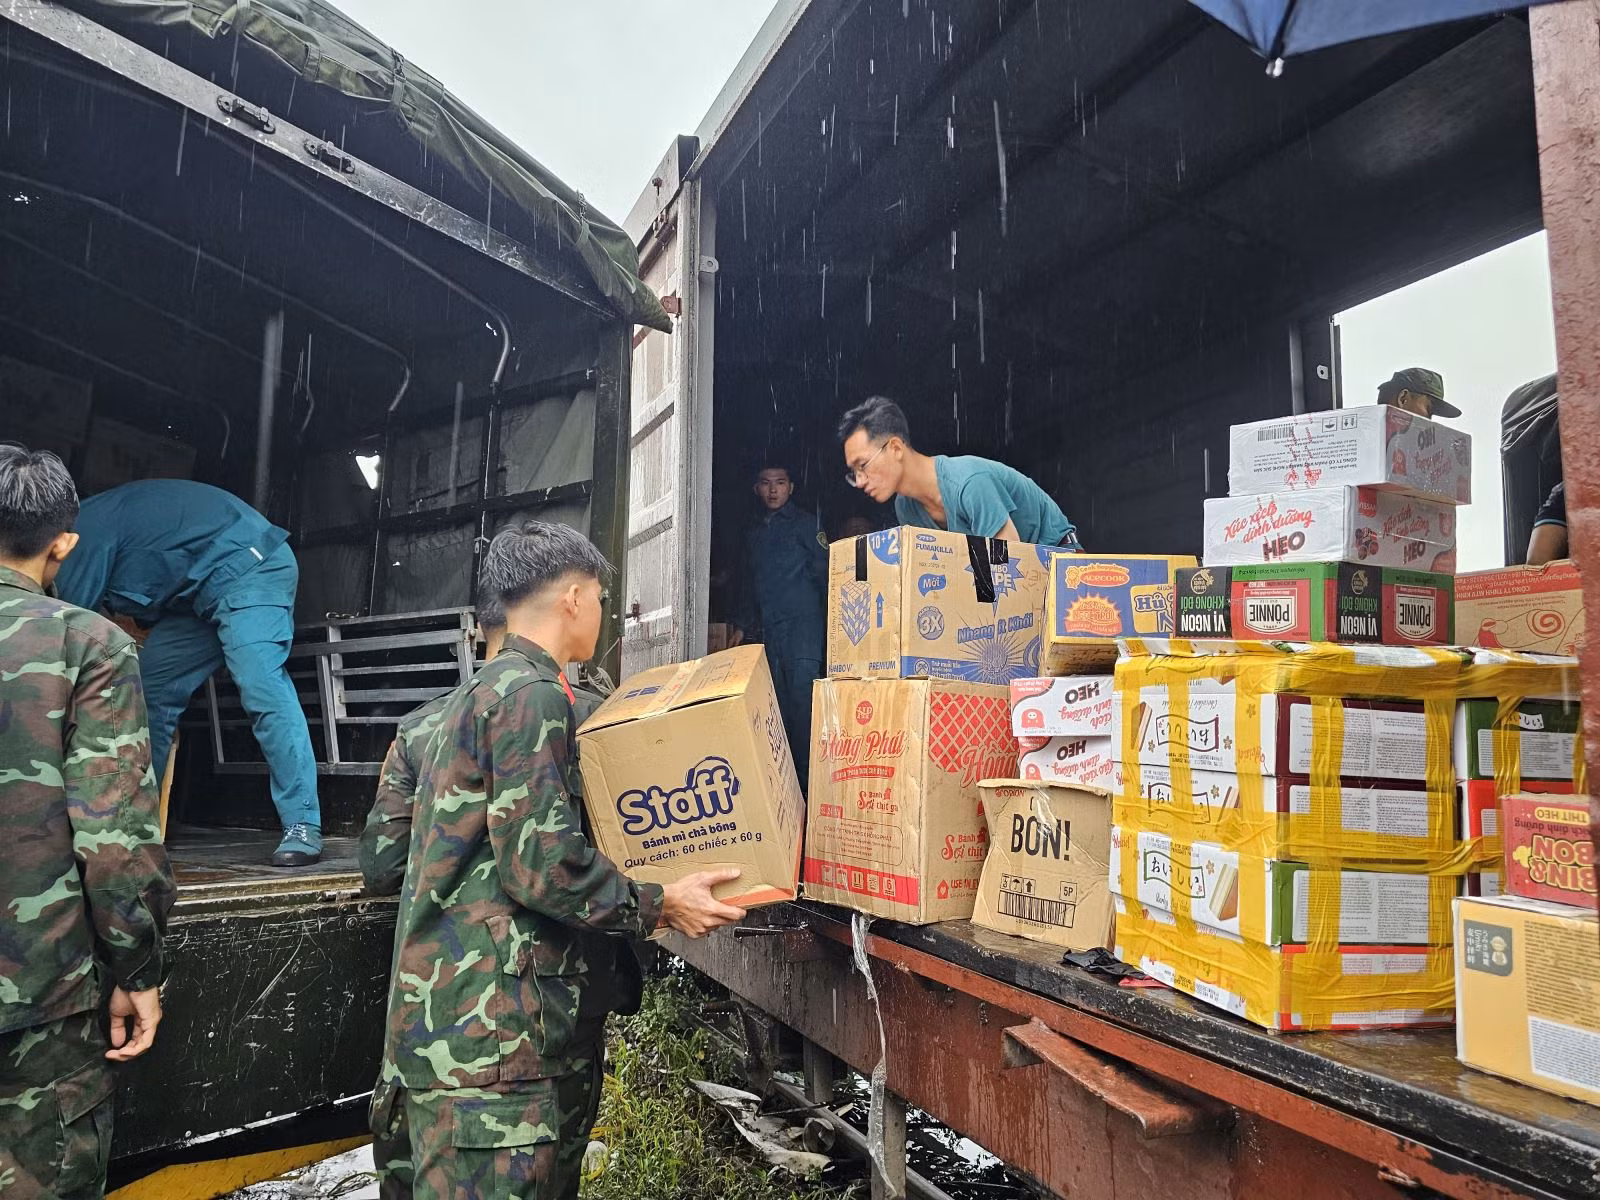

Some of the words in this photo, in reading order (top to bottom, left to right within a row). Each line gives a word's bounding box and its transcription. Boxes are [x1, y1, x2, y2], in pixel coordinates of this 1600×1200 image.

[1224, 519, 1247, 542] Xúc
[1242, 521, 1271, 544] dinh
[1272, 509, 1315, 530] dưỡng
[916, 543, 954, 554] FUMAKILLA
[1262, 531, 1306, 561] HEO
[1403, 539, 1426, 565] HEO
[923, 576, 940, 588] Mới
[993, 573, 1012, 588] APE
[1195, 596, 1224, 610] KHÔNG
[1249, 604, 1290, 624] PÖNNIE
[1354, 597, 1378, 613] KHÔNG
[918, 614, 943, 636] 3X
[958, 625, 994, 644] Nhang
[1008, 613, 1034, 631] Khói
[1181, 614, 1211, 632] NGON
[1213, 611, 1226, 632] VỊ
[1340, 616, 1366, 635] NGON
[1367, 614, 1378, 636] VỊ
[869, 661, 896, 671] PREMIUM
[1065, 682, 1100, 704] HEO
[820, 727, 863, 766] Hồng
[864, 729, 908, 761] Phát
[1057, 740, 1087, 761] HEO
[617, 765, 736, 836] Staff
[1537, 809, 1558, 820] HEO
[642, 834, 671, 850] Bánh
[672, 830, 687, 843] mì
[688, 826, 708, 839] chà
[710, 821, 737, 837] bông
[1011, 814, 1071, 861] BON!
[624, 855, 647, 869] Quy
[650, 848, 680, 863] cách:
[682, 844, 696, 856] 60
[698, 836, 728, 852] chiếc
[731, 836, 738, 845] x
[740, 831, 754, 843] 60
[755, 832, 763, 842] g
[1531, 833, 1594, 867] BON
[951, 880, 962, 889] USE
[1151, 857, 1199, 890] おいしい
[1063, 886, 1074, 897] 5P
